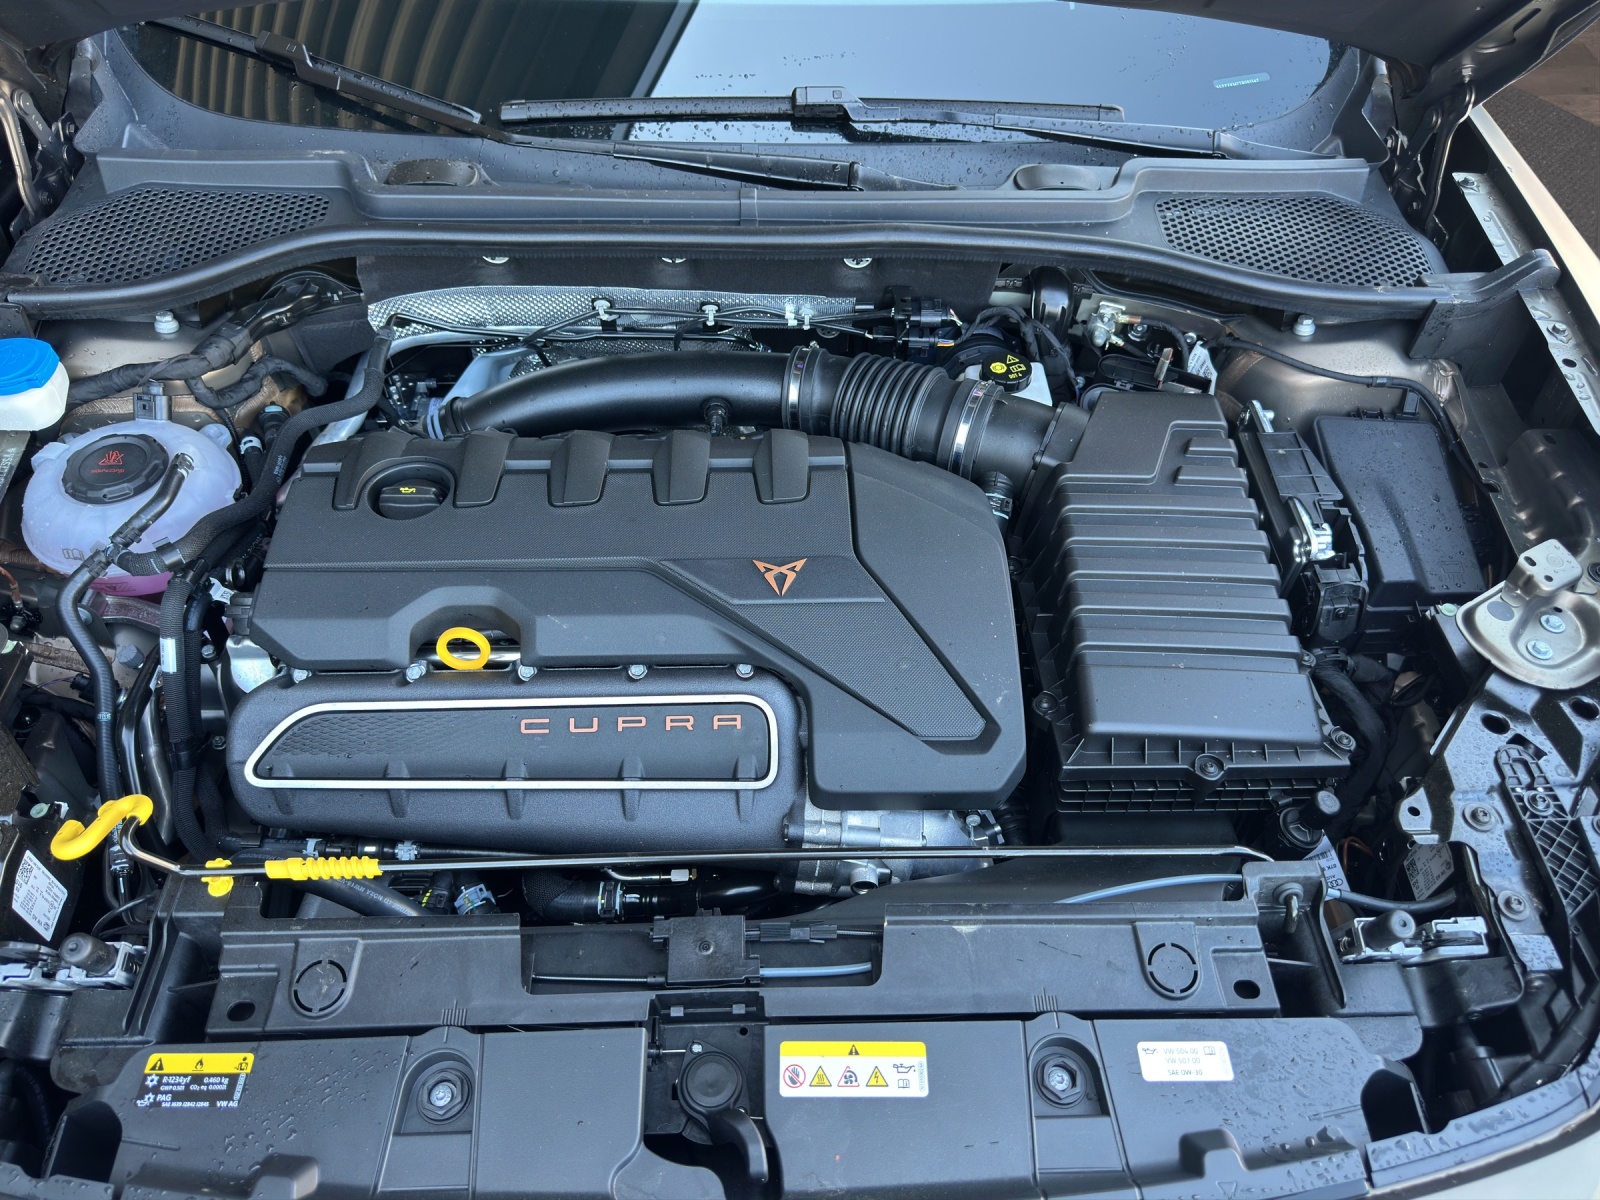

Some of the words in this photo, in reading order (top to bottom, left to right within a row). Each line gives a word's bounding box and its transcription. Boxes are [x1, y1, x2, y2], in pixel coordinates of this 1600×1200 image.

[520, 714, 742, 734] CUPRA
[162, 1075, 192, 1085] R-1234yf
[221, 1076, 229, 1085] kg
